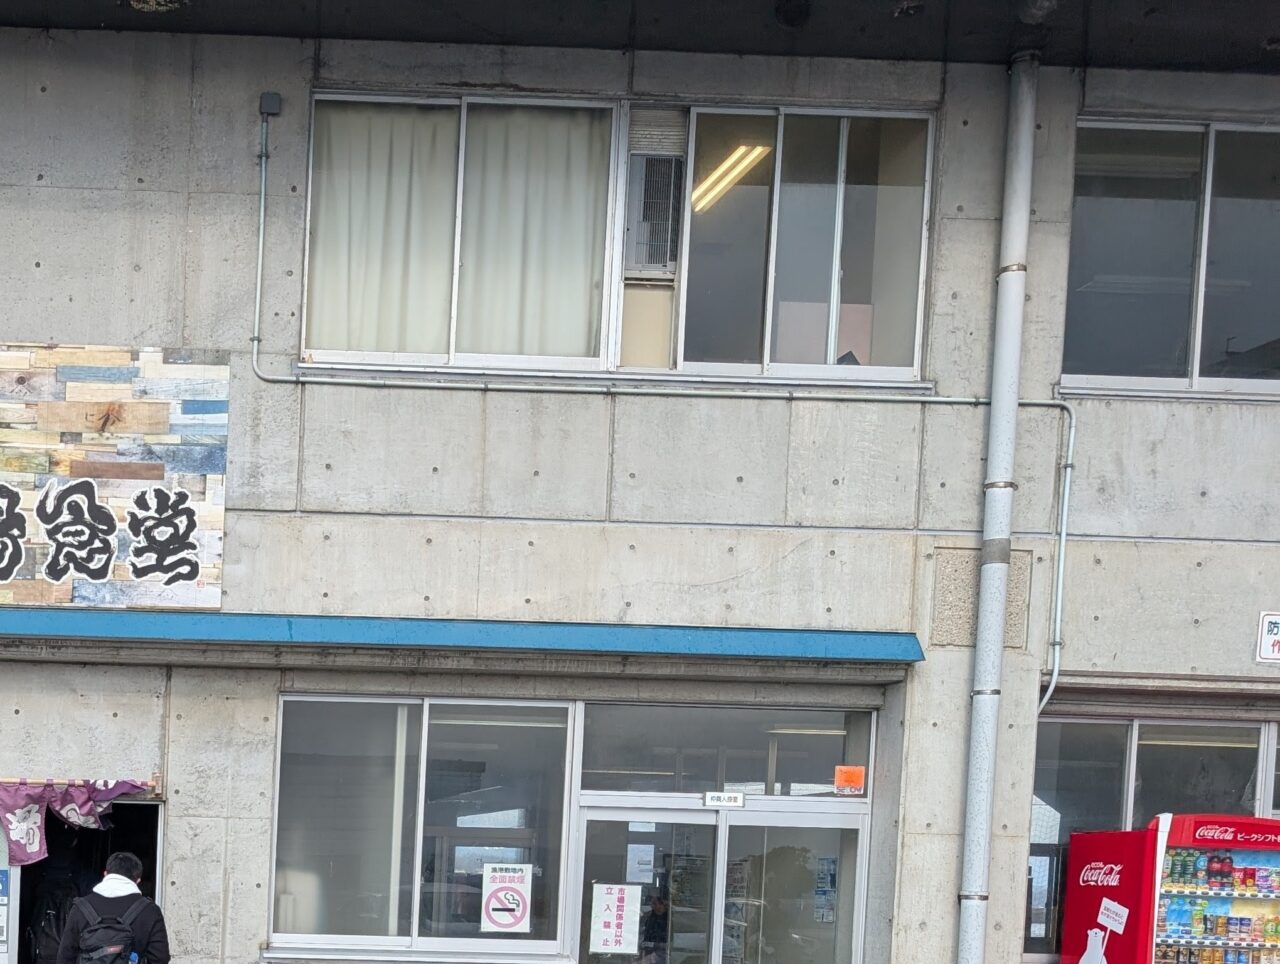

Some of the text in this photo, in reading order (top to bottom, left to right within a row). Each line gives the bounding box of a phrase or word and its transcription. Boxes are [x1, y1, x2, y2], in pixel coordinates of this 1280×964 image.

[836, 786, 863, 794] SEOM
[1237, 832, 1280, 843] ピークシフト
[489, 875, 526, 885] 全面禁煙
[602, 887, 614, 947] 立入禁止
